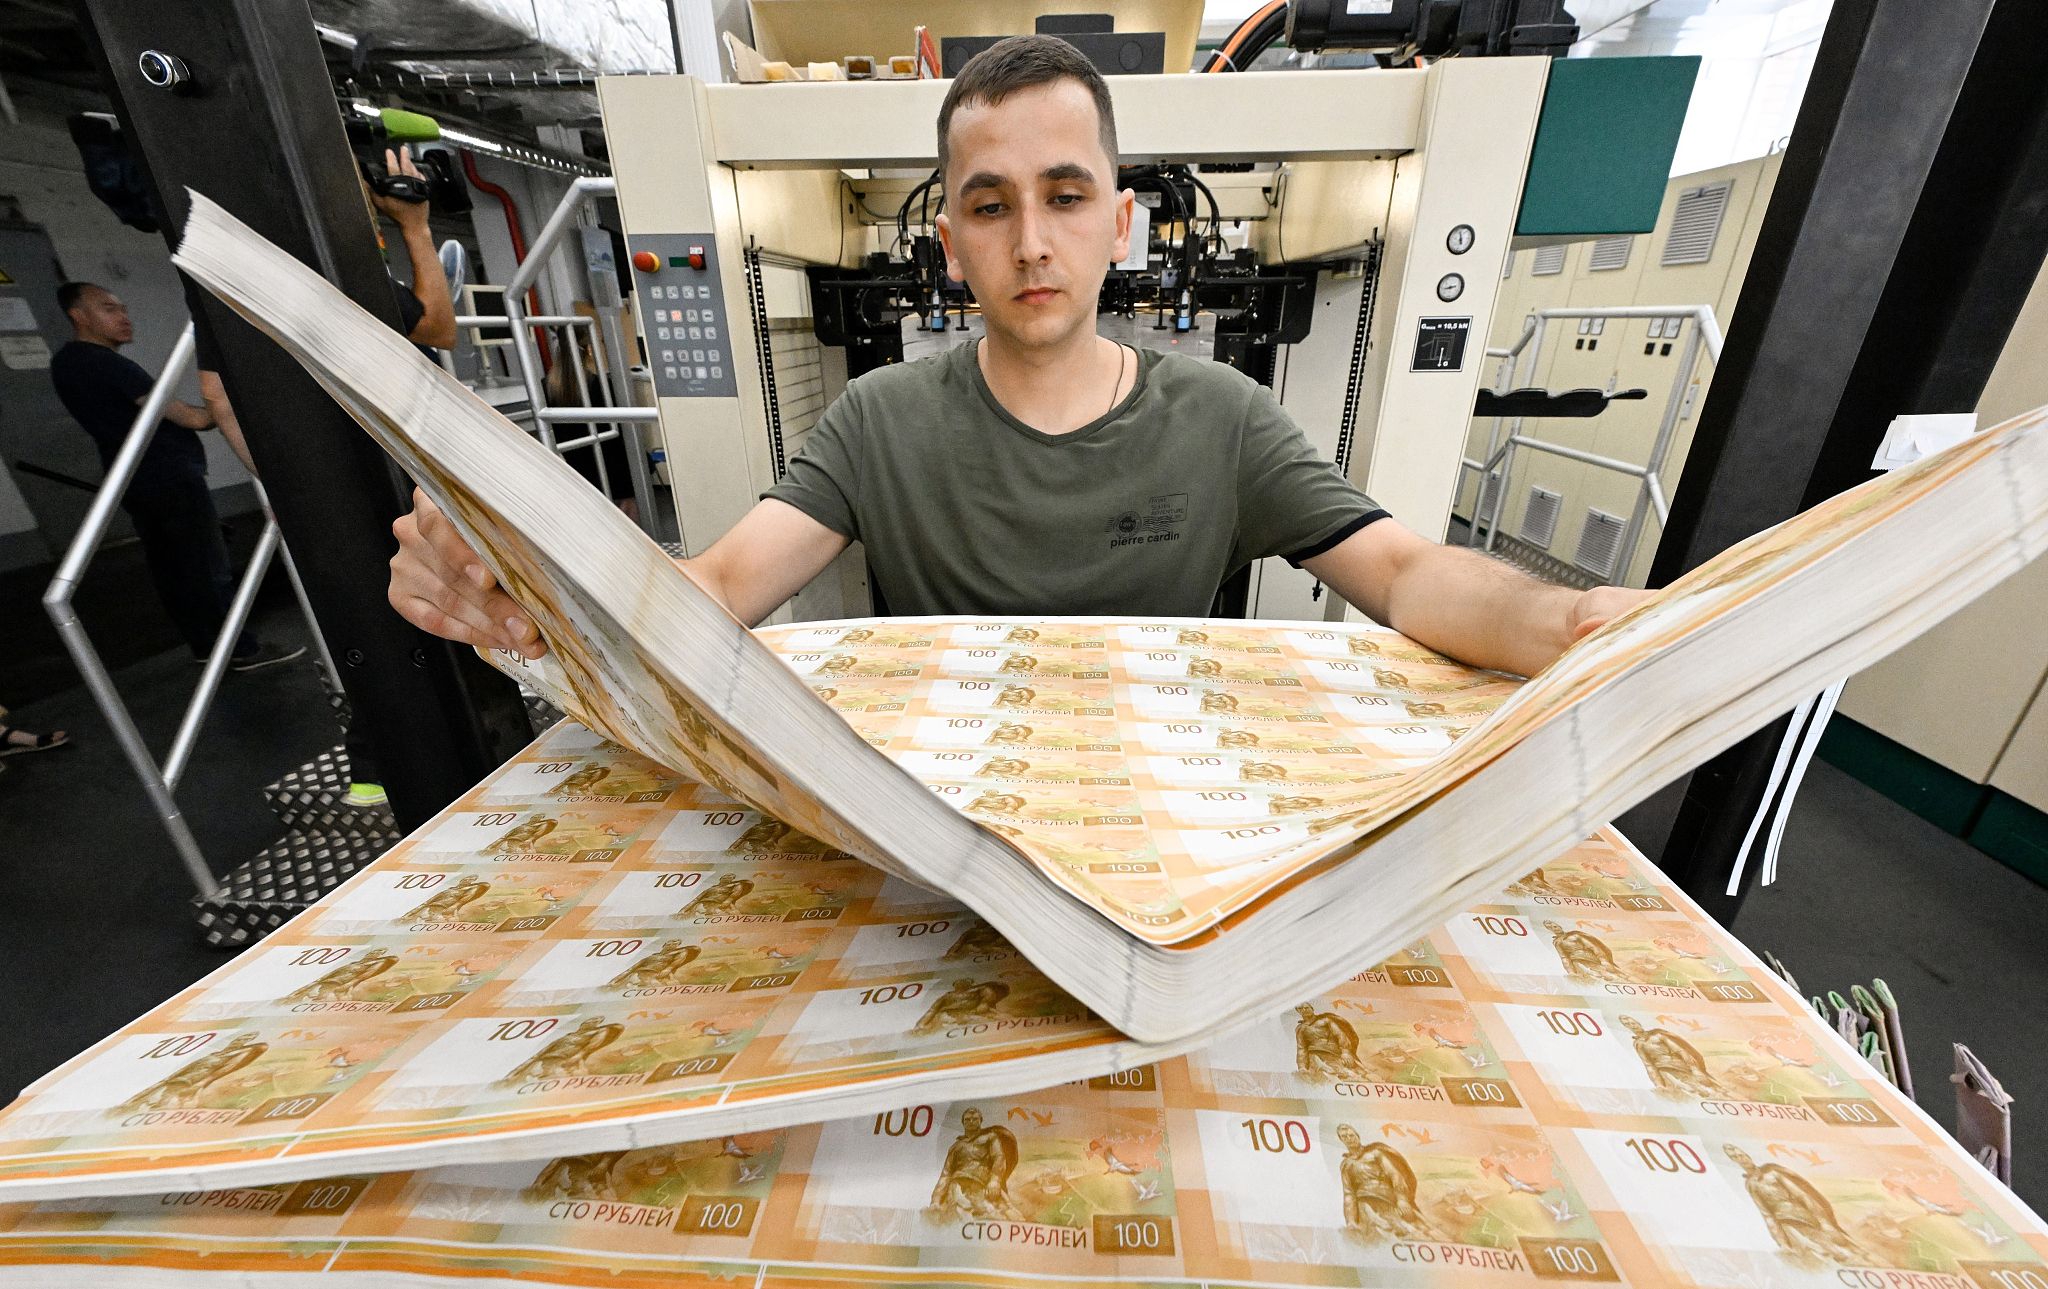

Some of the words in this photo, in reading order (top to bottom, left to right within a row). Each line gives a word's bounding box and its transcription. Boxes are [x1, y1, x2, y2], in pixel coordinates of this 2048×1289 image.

[1110, 536, 1144, 549] pierre
[1147, 532, 1179, 542] cardin
[1304, 632, 1335, 640] 100
[1145, 653, 1177, 661] 100
[1326, 662, 1359, 672] 100
[957, 682, 990, 690] 100
[1153, 686, 1187, 695] 100
[1352, 696, 1388, 706] 100
[947, 719, 983, 728] 100
[1163, 725, 1202, 733] 100
[1385, 726, 1427, 734] 100
[933, 753, 974, 761] 100
[1177, 757, 1221, 766] 100
[534, 763, 573, 774] 100
[583, 795, 626, 803] РУБЛЕЙ
[638, 792, 662, 800] 100
[1196, 792, 1246, 801] 100
[472, 813, 517, 827] 100
[702, 812, 744, 826] 100
[1221, 826, 1280, 839] 100
[494, 854, 519, 862] СТО
[520, 853, 571, 862] РУБЛЕЙ
[585, 851, 612, 860] 100
[743, 853, 767, 861] СТО
[771, 853, 820, 861] РУБЛЕЙ
[1108, 864, 1147, 872] 100
[394, 874, 446, 889] 100
[654, 873, 702, 888] 100
[1534, 896, 1562, 906] СТО
[1563, 896, 1617, 910] РУБЛЕЙ
[1627, 897, 1663, 909] 100
[693, 916, 723, 925] СТО
[725, 914, 782, 923] РУБЛЕЙ
[801, 910, 831, 919] 100
[409, 923, 439, 932] СТО
[440, 922, 497, 933] РУБЛЕЙ
[512, 918, 545, 929] 100
[897, 920, 950, 937] 100
[1472, 916, 1527, 937] 100
[288, 947, 351, 965] 100
[586, 940, 643, 958] 100
[972, 952, 1007, 964] СТО
[750, 975, 787, 987] 100
[1403, 969, 1439, 983] 100
[623, 988, 657, 998] СТО
[661, 984, 727, 995] РУБЛЕЙ
[859, 983, 923, 1005] 100
[1604, 984, 1637, 996] СТО
[1639, 984, 1701, 1000] РУБЛЕЙ
[1712, 985, 1753, 1000] 100
[292, 1003, 326, 1012] СТО
[327, 1002, 395, 1013] РУБЛЕЙ
[412, 995, 452, 1008] 100
[488, 1019, 558, 1041] 100
[947, 1023, 989, 1039] СТО
[996, 1012, 1080, 1031] РУБЛЕЙ
[1537, 1010, 1602, 1037] 100
[138, 1033, 217, 1059] 100
[672, 1057, 718, 1076] 100
[517, 1080, 560, 1095] СТО
[562, 1074, 645, 1089] РУБЛЕЙ
[1109, 1068, 1143, 1086] 100
[1335, 1083, 1369, 1097] СТО
[1375, 1084, 1444, 1101] РУБЛЕЙ
[1462, 1082, 1505, 1102] 100
[264, 1097, 317, 1118] 100
[1701, 1101, 1739, 1117] СТО
[1741, 1102, 1817, 1122] РУБЛЕЙ
[1827, 1103, 1877, 1123] 100
[121, 1113, 163, 1127] СТО
[166, 1110, 248, 1125] РУБЛЕЙ
[873, 1105, 934, 1136] 100
[1242, 1119, 1311, 1154] 100
[1625, 1138, 1707, 1174] 100
[161, 1192, 201, 1205] СТО
[201, 1190, 284, 1210] РУБЛЕЙ
[302, 1185, 351, 1209] 100
[550, 1202, 590, 1220] СТО
[593, 1204, 675, 1227] РУБЛЕЙ
[700, 1203, 743, 1228] 100
[961, 1222, 1002, 1241] СТО
[1010, 1225, 1087, 1248] РУБЛЕЙ
[1114, 1221, 1159, 1248] 100
[1392, 1243, 1435, 1264] СТО
[1440, 1245, 1525, 1273] РУБЛЕЙ
[1544, 1245, 1599, 1275] 100
[1837, 1269, 1886, 1289] СТО
[1886, 1272, 1972, 1289] РУБЛЕЙ
[1989, 1270, 2048, 1289] 100
